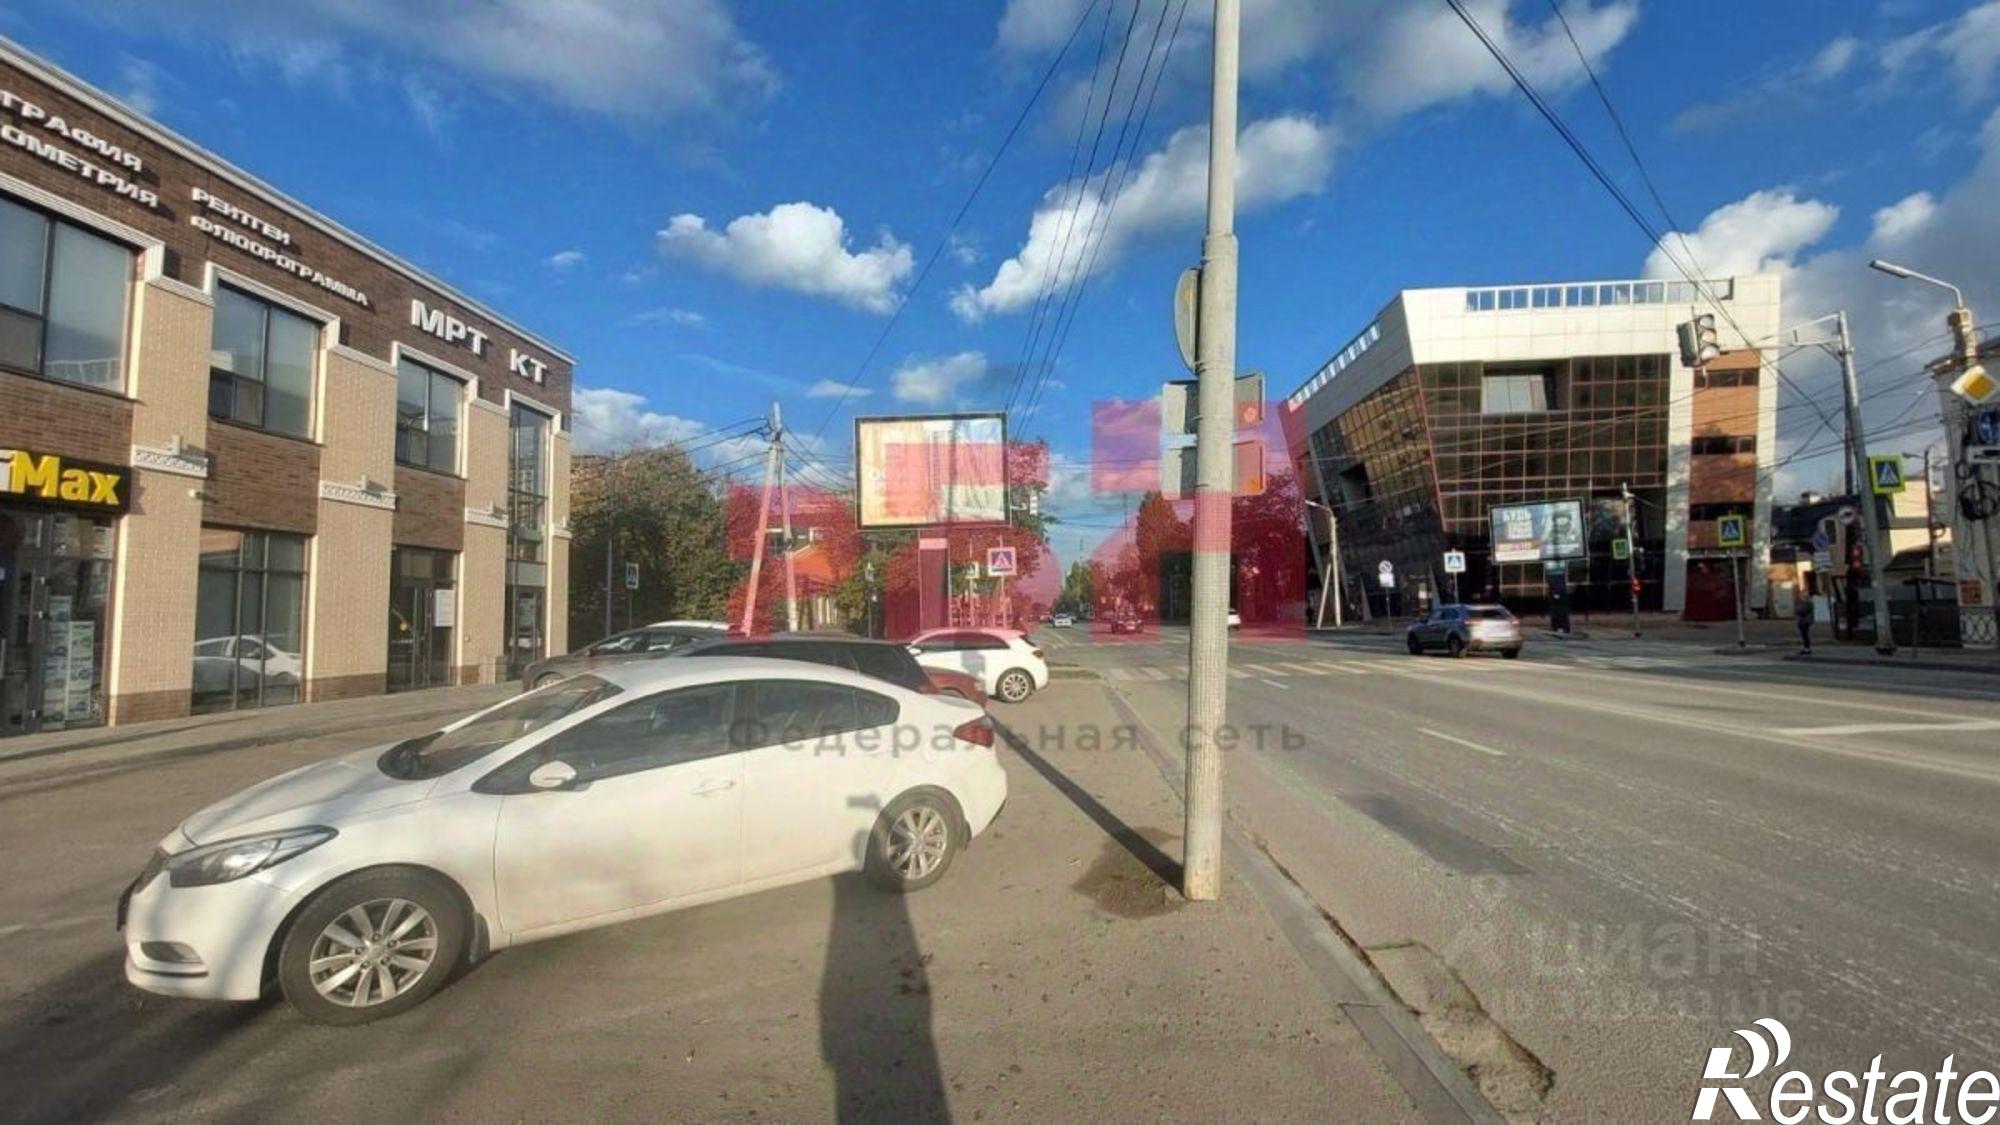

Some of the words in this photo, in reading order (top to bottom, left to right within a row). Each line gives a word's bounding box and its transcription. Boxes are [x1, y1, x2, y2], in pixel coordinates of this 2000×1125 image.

[1, 124, 160, 208] ОМЕТРИЯ
[191, 187, 290, 246] РЕНТГЕН
[411, 299, 488, 355] МРТ
[510, 348, 547, 384] КТ
